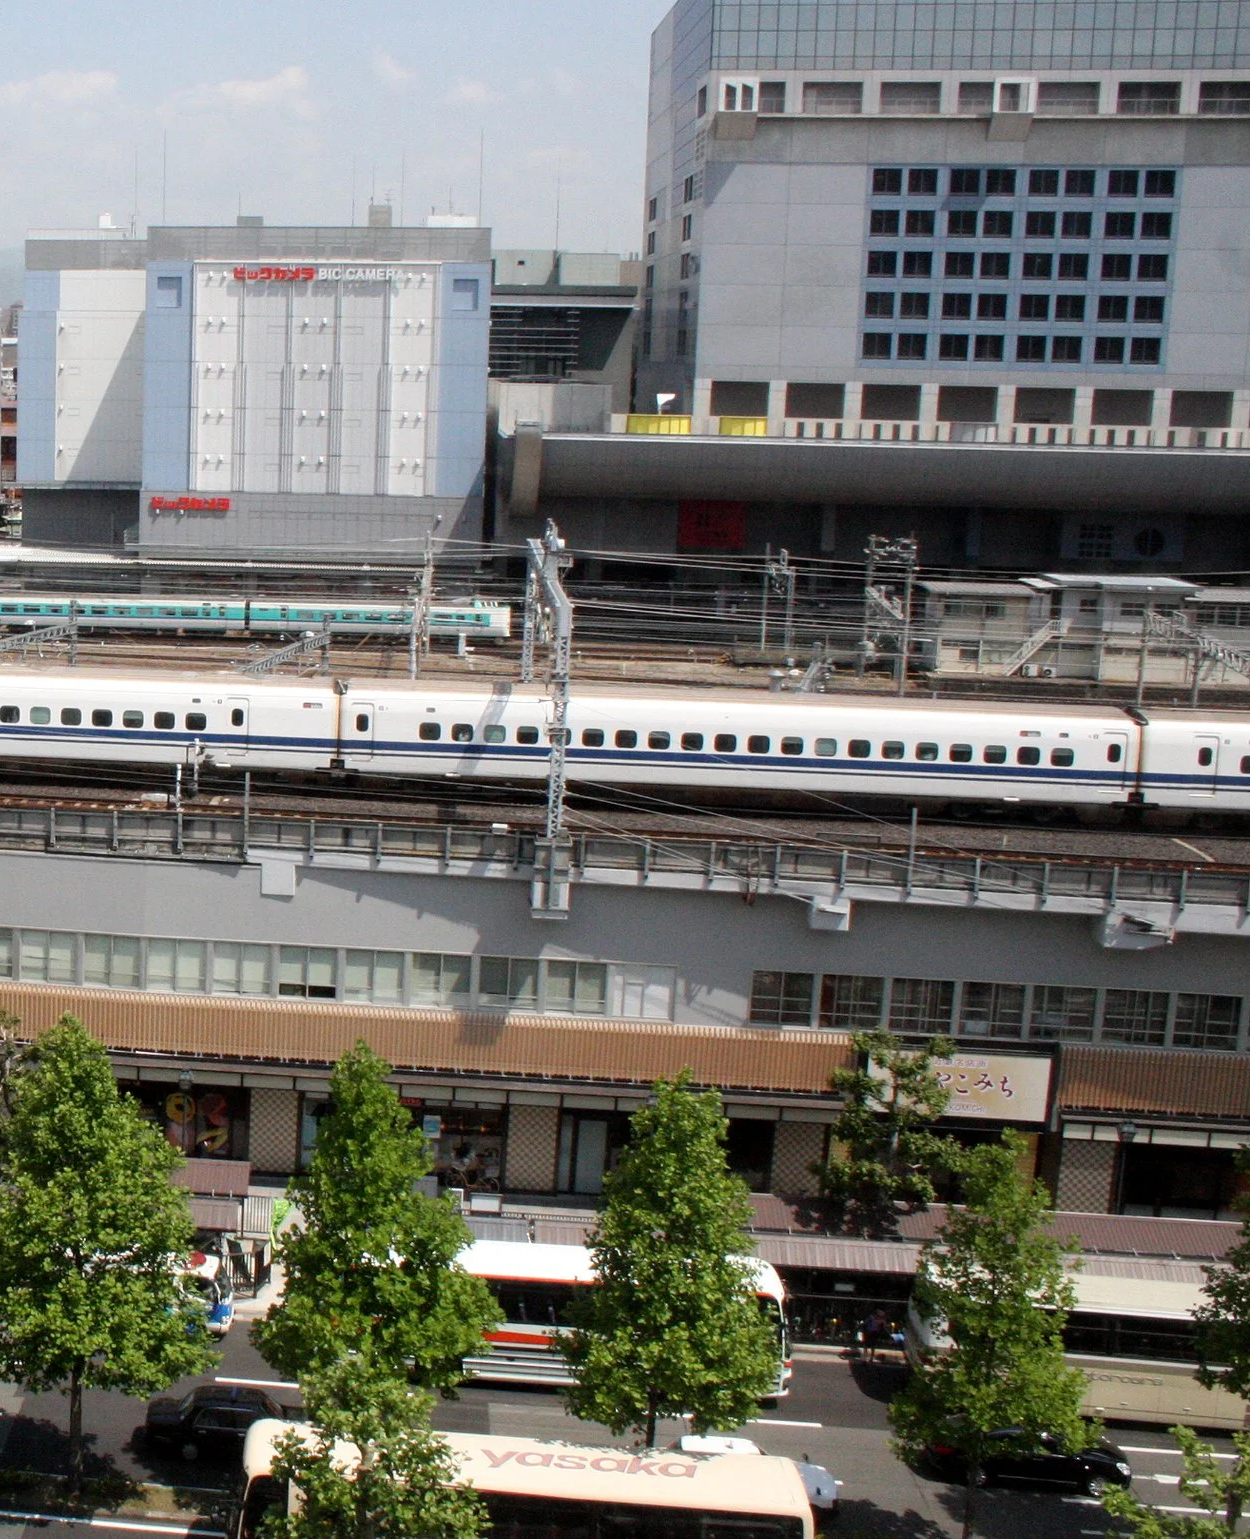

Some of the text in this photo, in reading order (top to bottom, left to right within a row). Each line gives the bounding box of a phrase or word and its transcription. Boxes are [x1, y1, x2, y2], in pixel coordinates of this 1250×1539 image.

[233, 266, 315, 281] ビックカメラ
[318, 267, 404, 281] BIC CAMERA
[933, 1071, 1013, 1098] やこみち
[480, 1448, 698, 1478] yasaka
